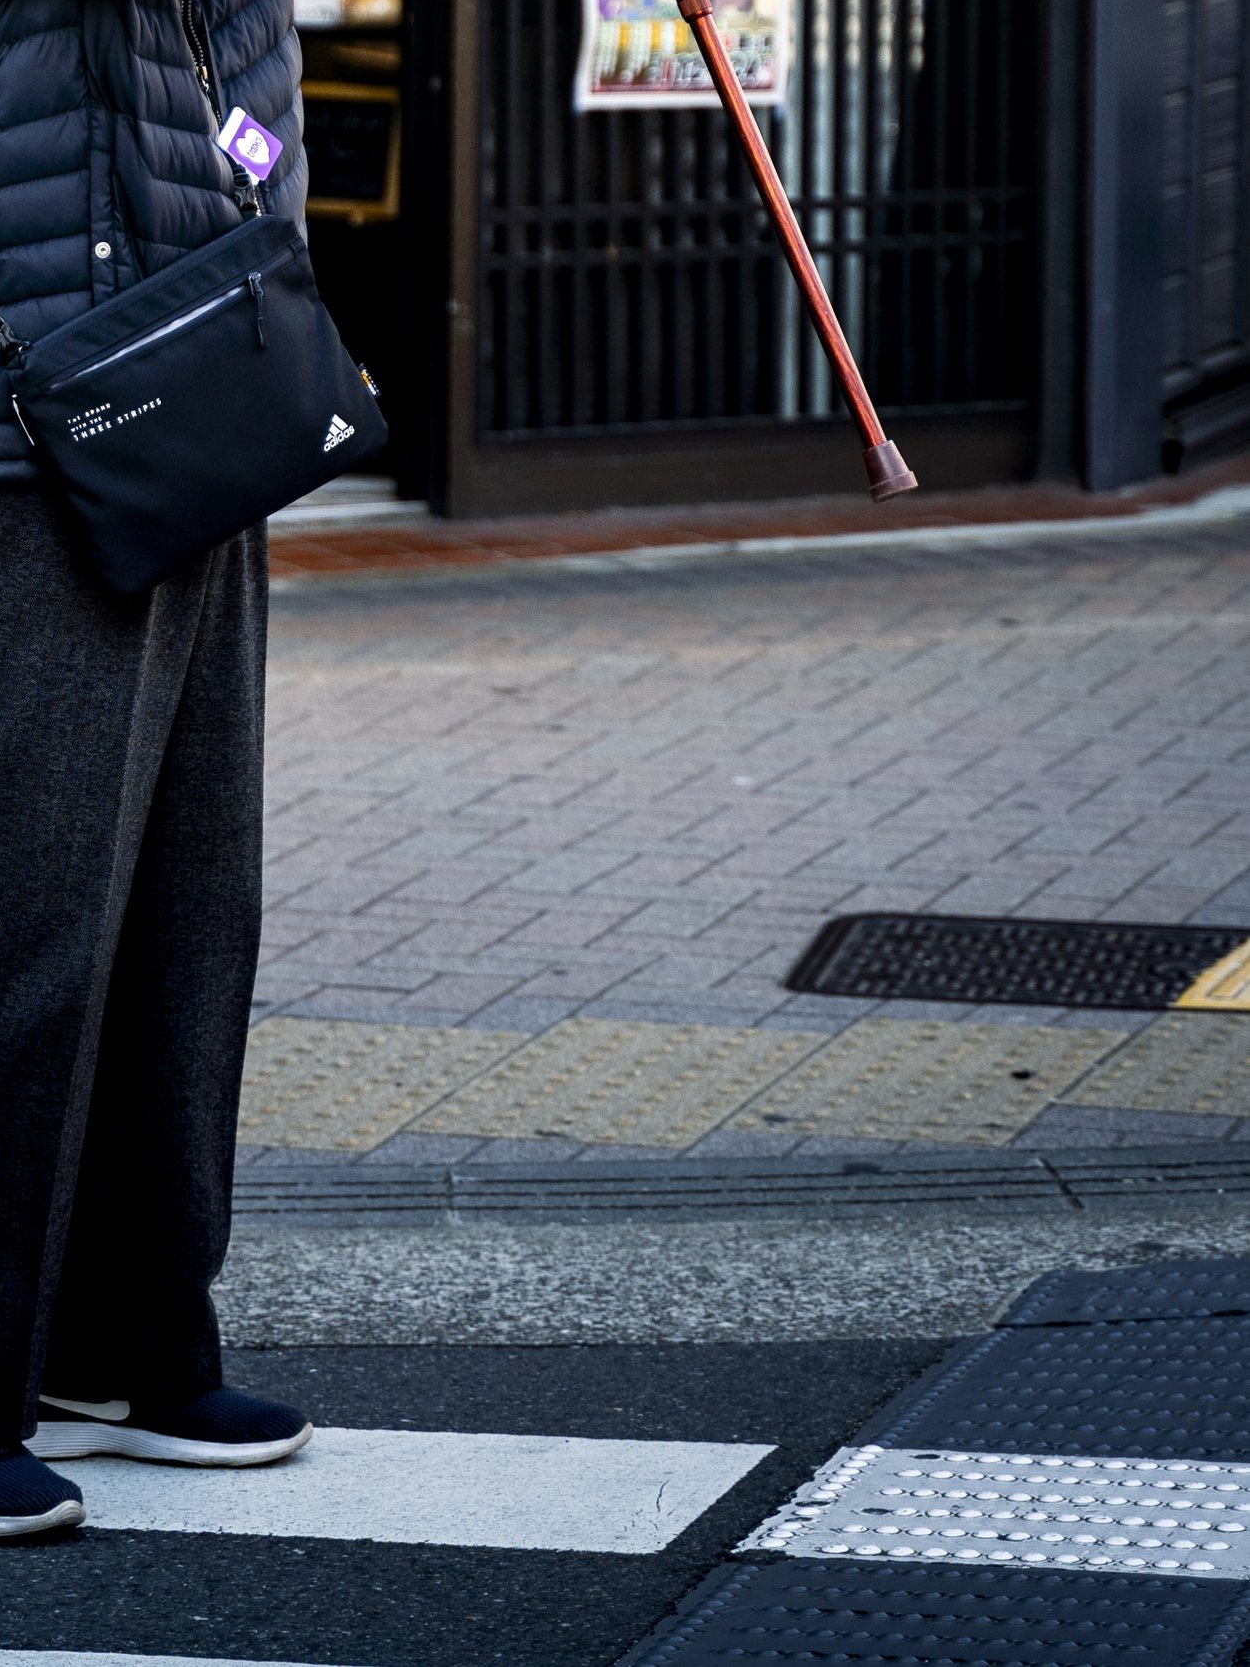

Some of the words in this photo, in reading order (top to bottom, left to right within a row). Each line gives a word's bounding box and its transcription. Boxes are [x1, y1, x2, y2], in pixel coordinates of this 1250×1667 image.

[73, 420, 112, 442] THREE
[116, 397, 162, 424] STRIPES
[84, 402, 111, 418] BRAND
[323, 425, 355, 452] adidas
